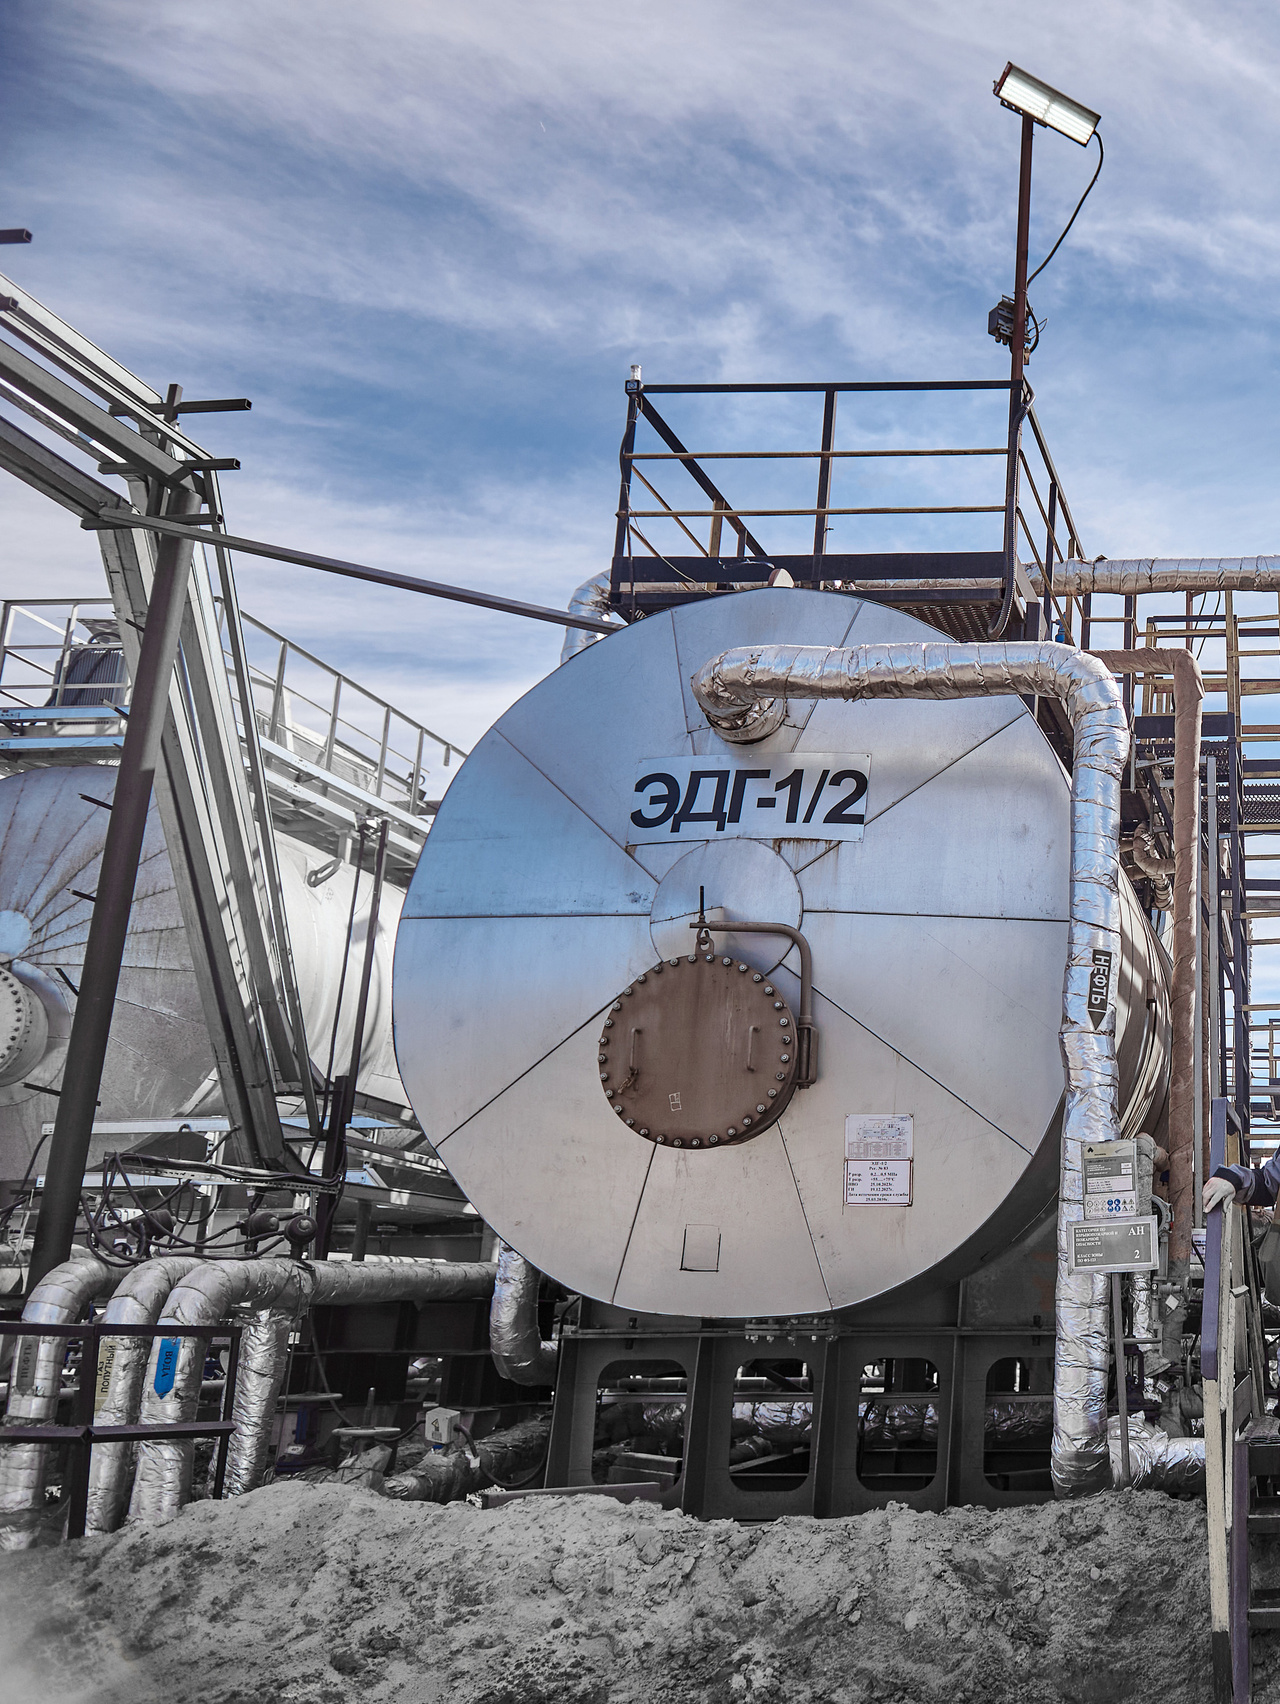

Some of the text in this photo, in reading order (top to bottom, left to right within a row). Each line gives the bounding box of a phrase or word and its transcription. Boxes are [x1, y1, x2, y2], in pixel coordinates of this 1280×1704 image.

[630, 769, 868, 833] ЭДГ-1/2
[1091, 954, 1110, 1005] НЕФТЬ
[1128, 1226, 1144, 1236] АН
[1134, 1250, 1140, 1259] 2
[101, 1345, 116, 1393] ПОПУТНЫЙ
[162, 1351, 174, 1378] ВОДА
